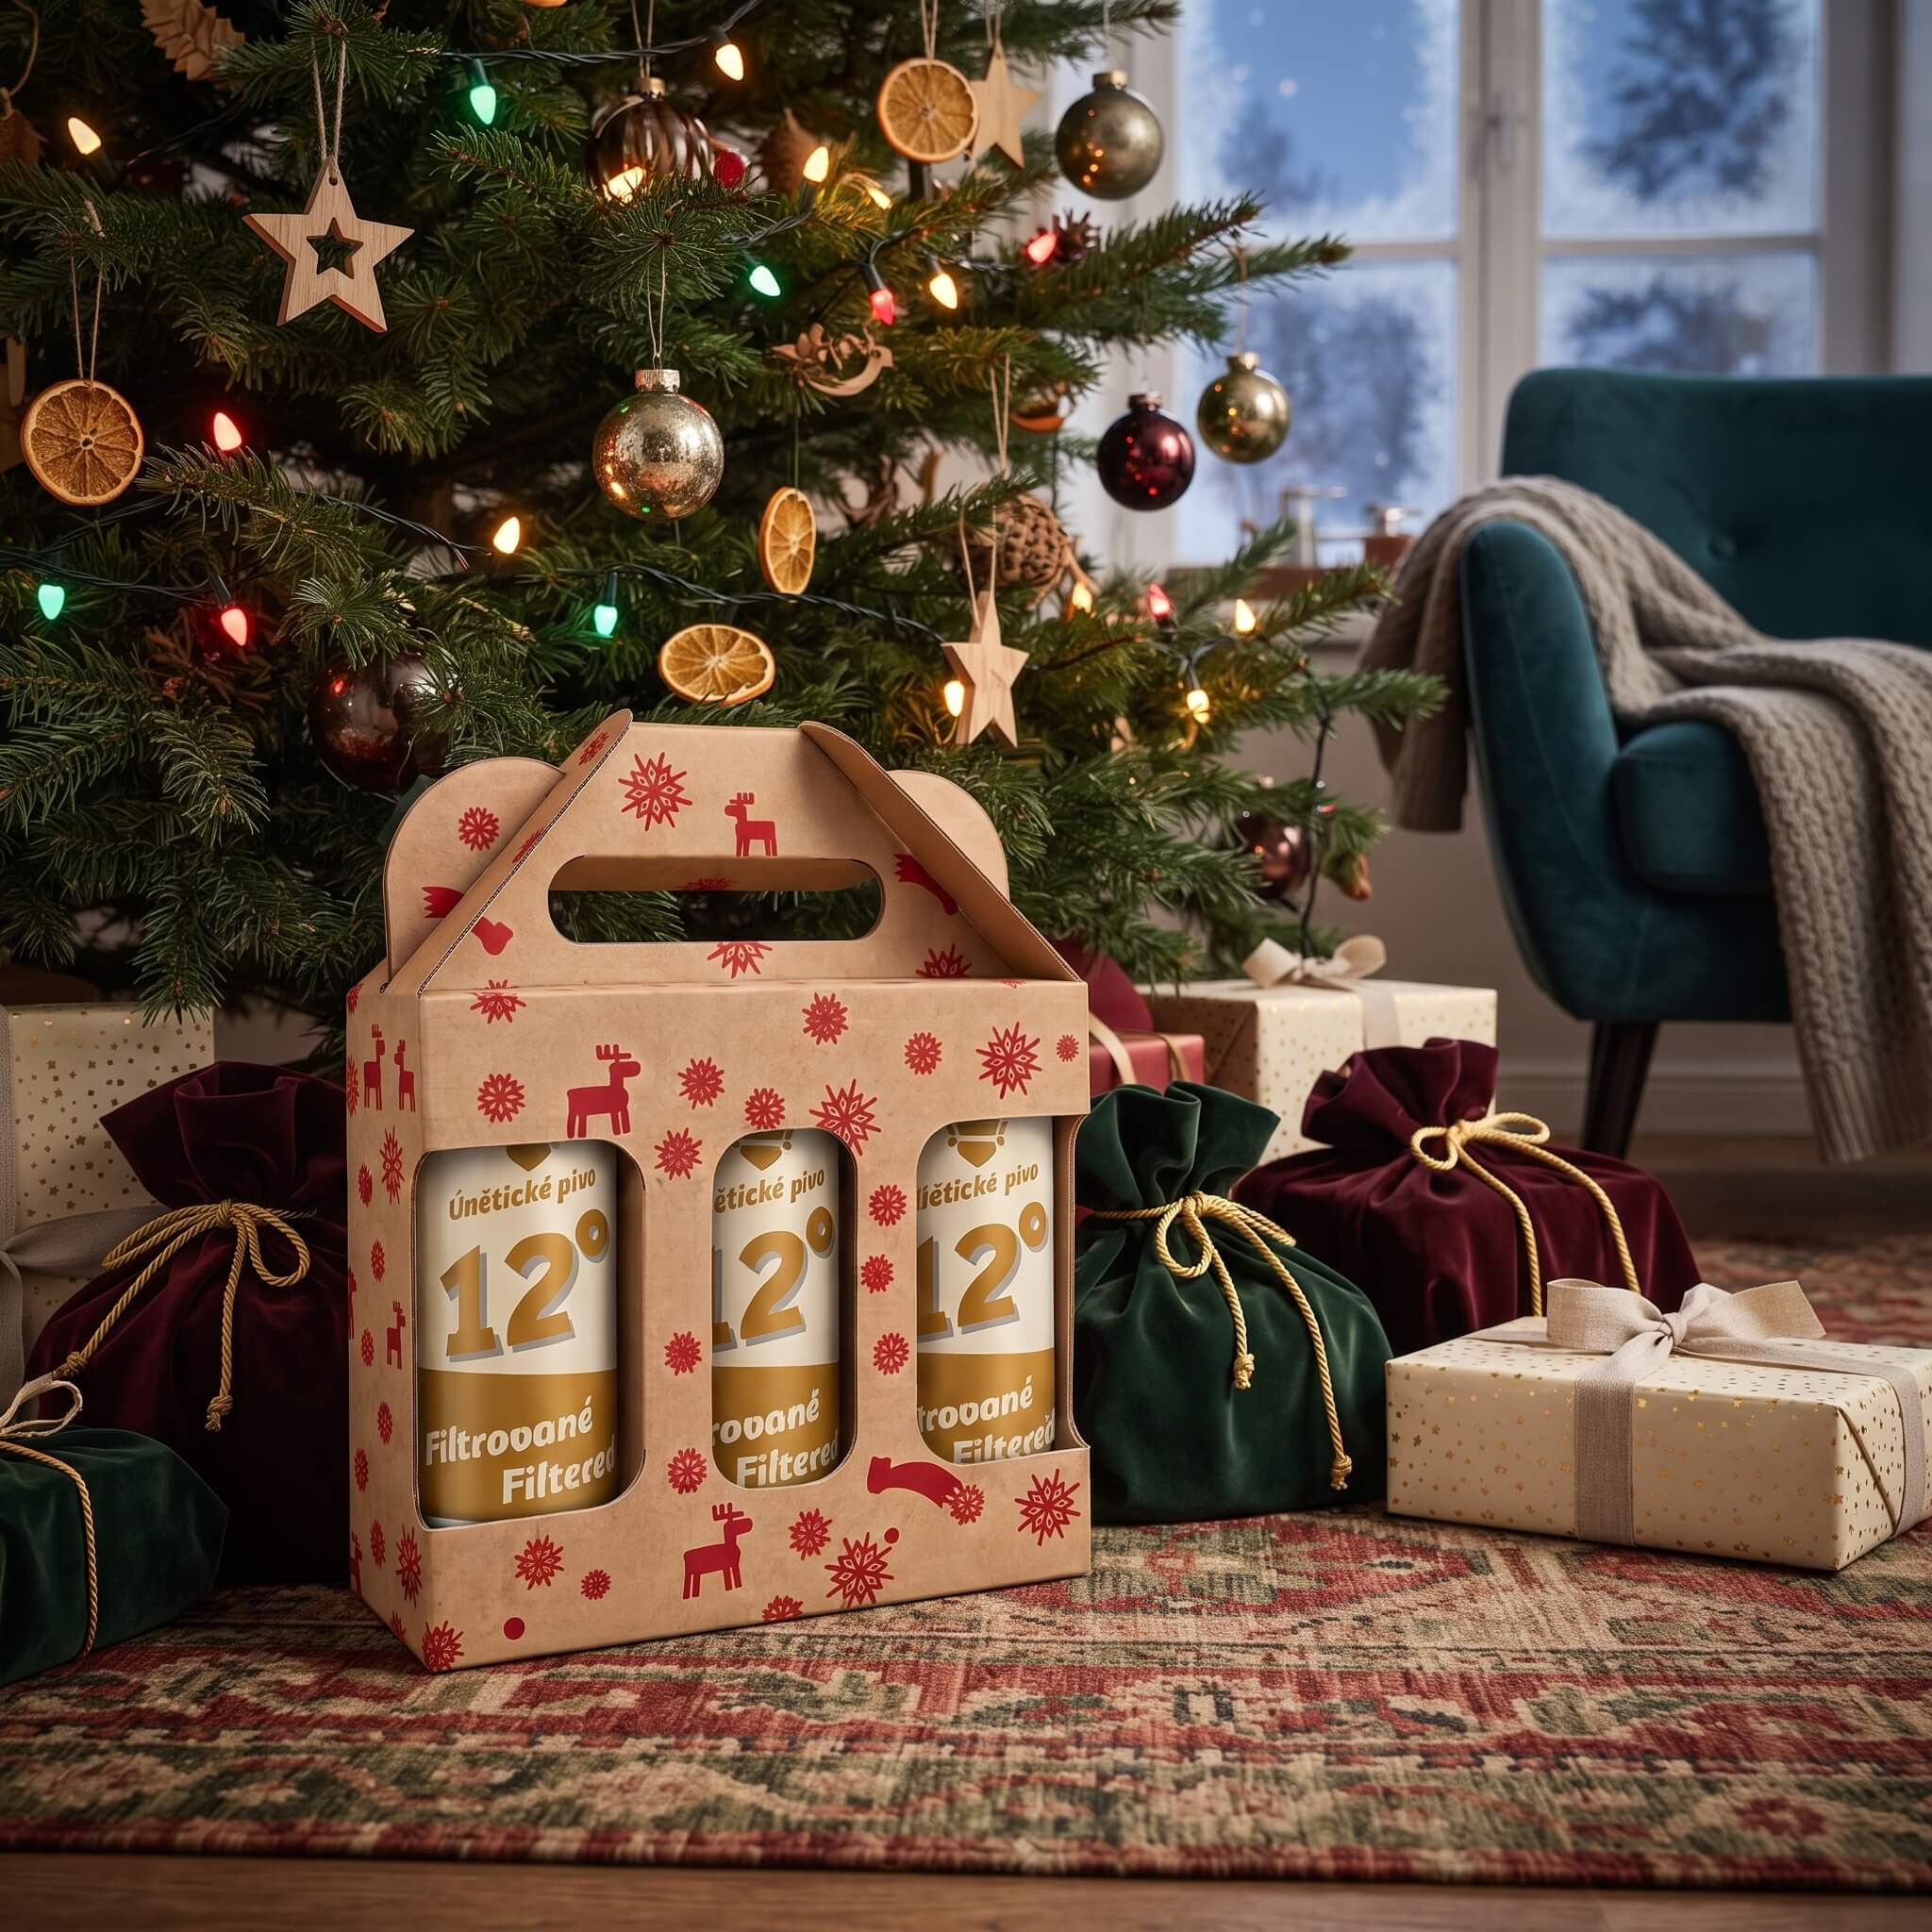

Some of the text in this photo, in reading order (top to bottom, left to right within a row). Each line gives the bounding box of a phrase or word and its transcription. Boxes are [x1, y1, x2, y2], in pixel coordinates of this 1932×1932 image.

[449, 1169, 596, 1220] Únětické pivo
[713, 1175, 785, 1213] ětické
[1004, 1163, 1039, 1196] pivo
[425, 1395, 593, 1466] Filtrované
[917, 1374, 1033, 1433] trované
[502, 1433, 616, 1505] Filtered
[737, 1427, 839, 1488] Filtered
